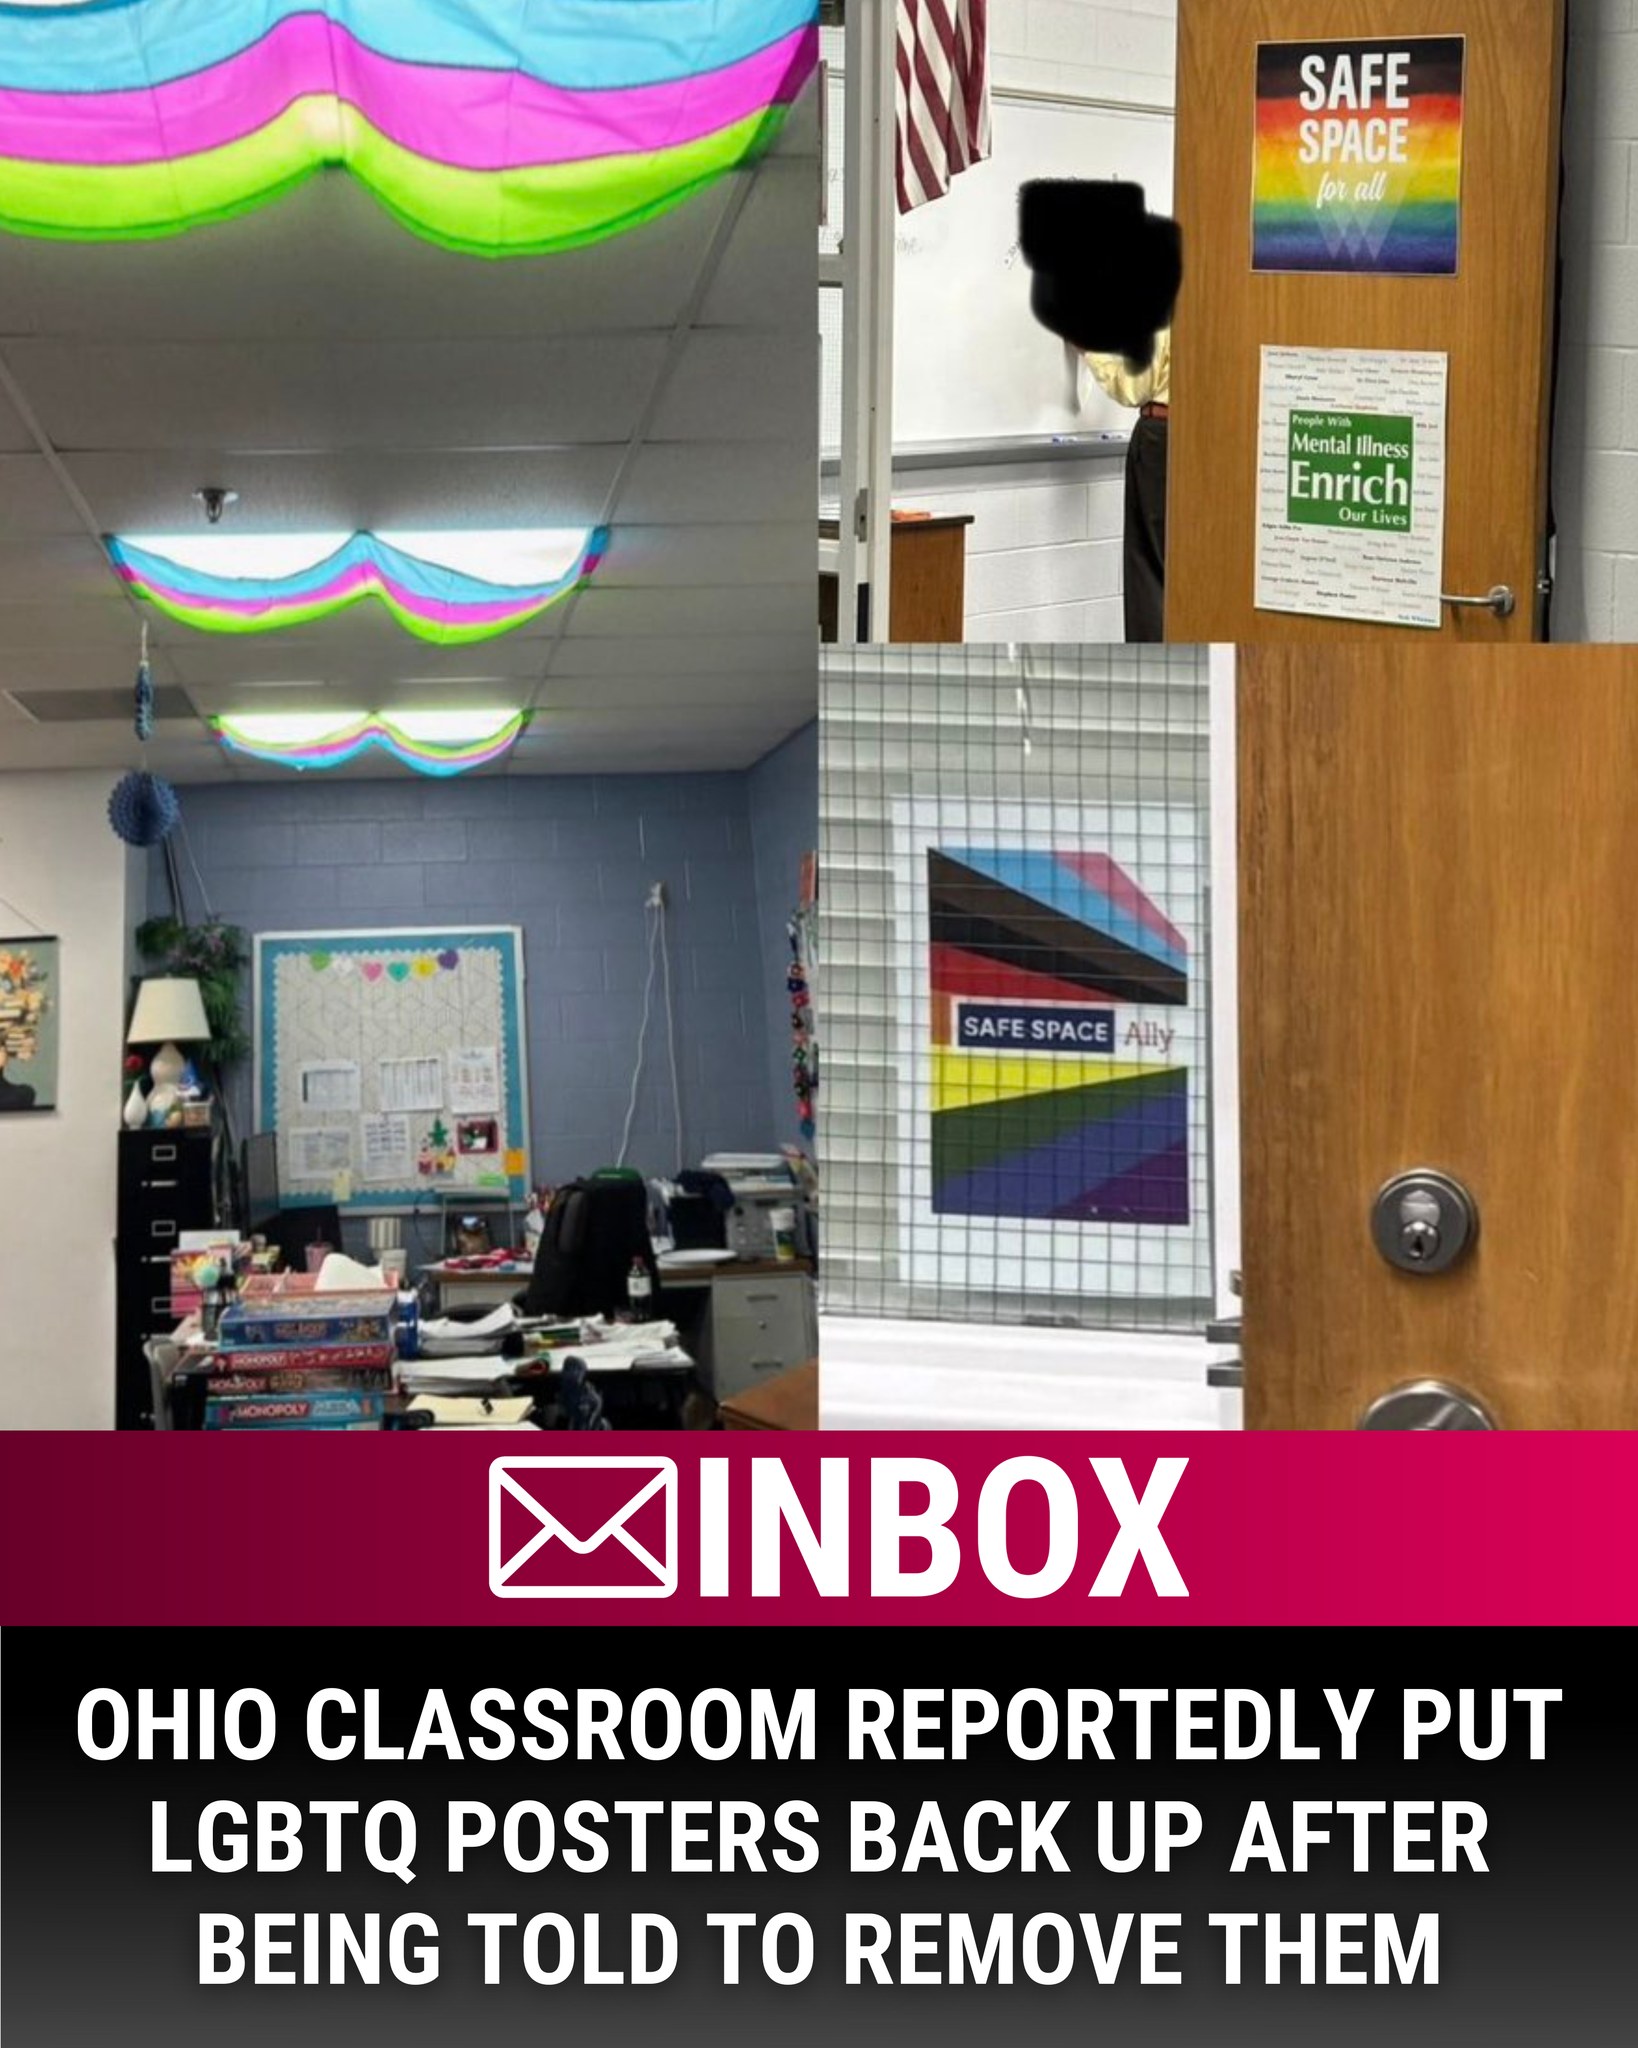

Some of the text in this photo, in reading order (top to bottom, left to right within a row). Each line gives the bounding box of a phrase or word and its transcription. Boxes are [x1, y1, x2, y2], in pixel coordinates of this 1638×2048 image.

[1300, 52, 1411, 112] SAFE
[1299, 117, 1409, 165] SPACE
[1316, 170, 1388, 209] for all
[1292, 414, 1352, 428] People With
[1291, 431, 1409, 459] Mental Illness
[1291, 460, 1409, 506] Enrich
[1339, 506, 1408, 525] Our Lives
[964, 1016, 1175, 1053] SAFE SPACE Ally
[234, 1353, 287, 1367] MONOPOLY
[238, 1402, 309, 1418] MONOPOLY
